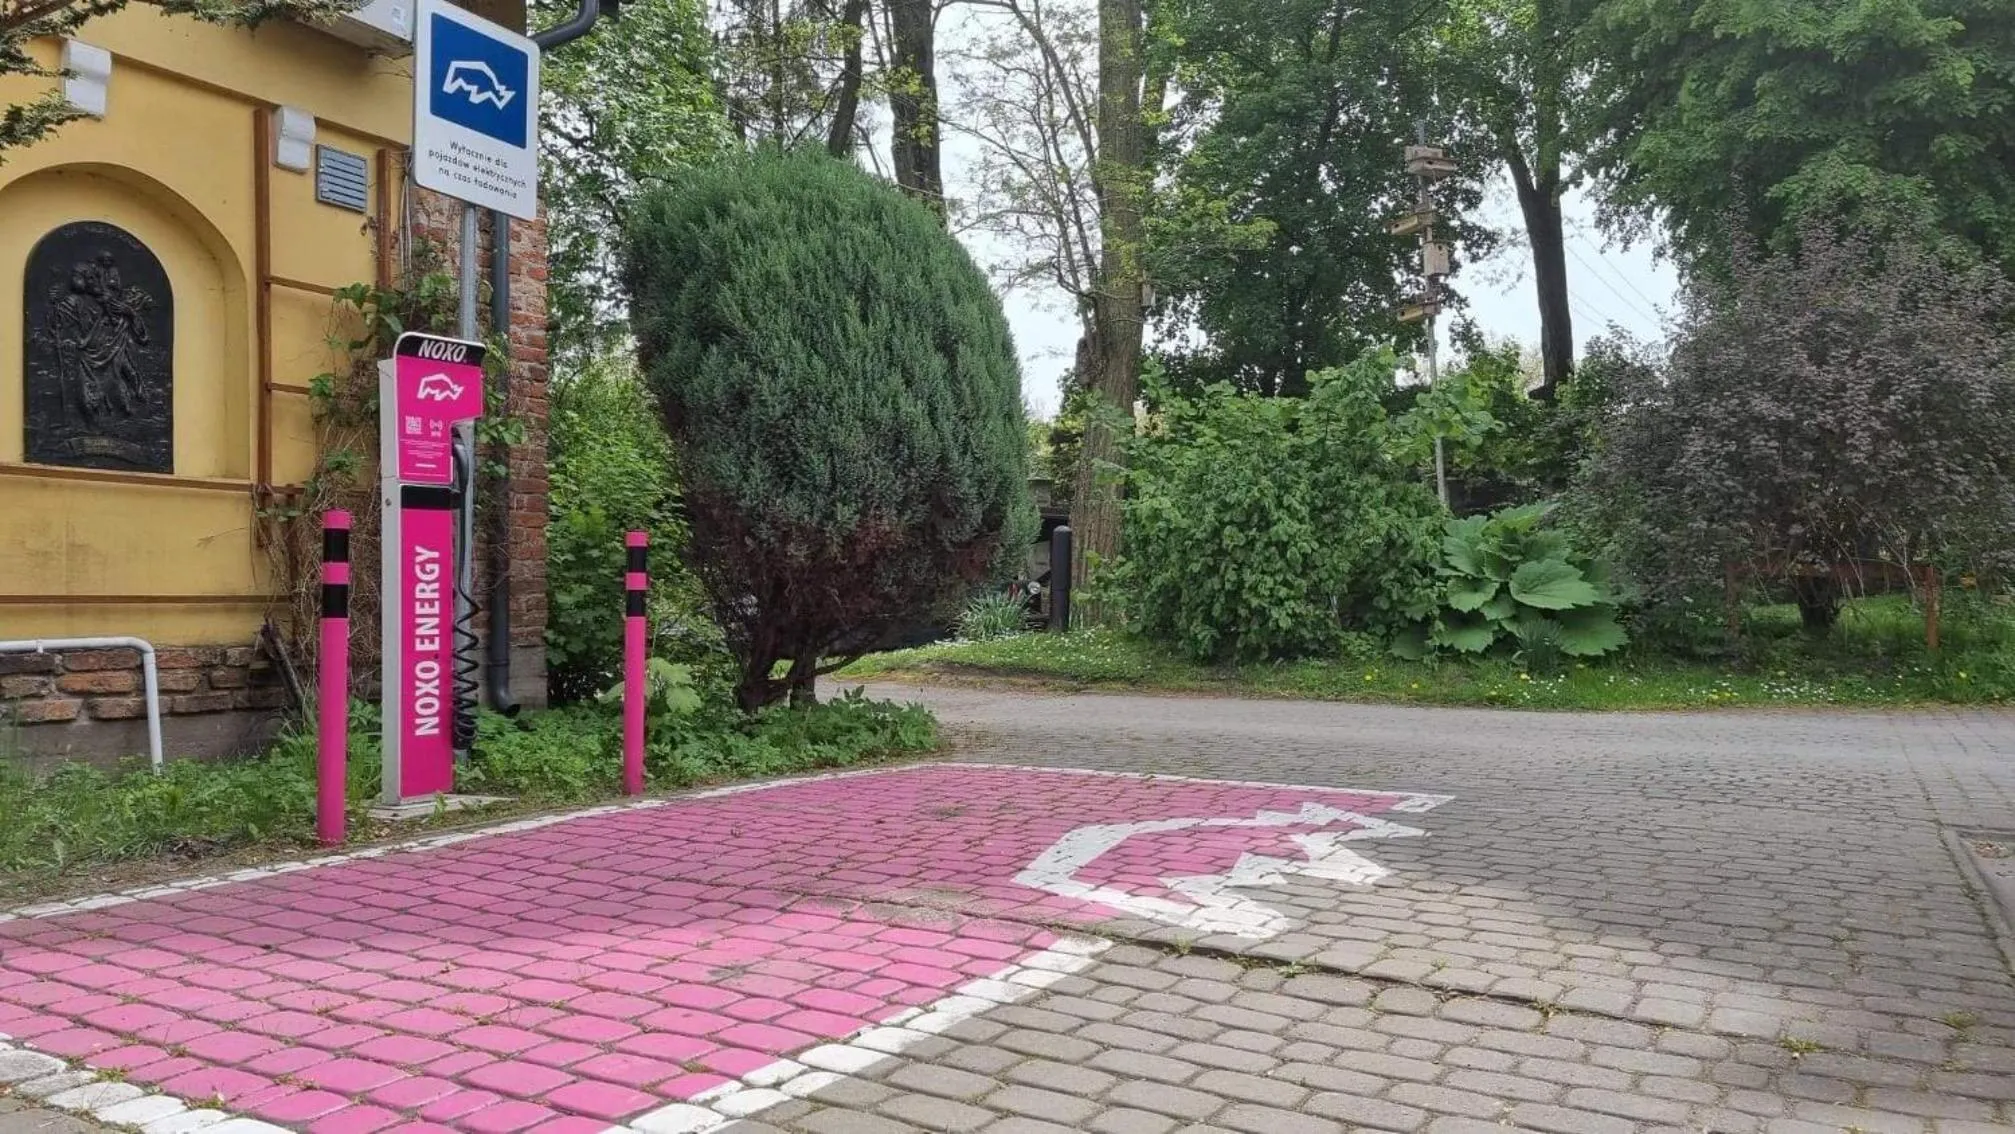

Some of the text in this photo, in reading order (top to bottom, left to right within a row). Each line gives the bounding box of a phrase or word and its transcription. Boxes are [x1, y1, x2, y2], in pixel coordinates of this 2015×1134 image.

[429, 150, 527, 188] pojazdów elektrycznych
[450, 141, 507, 168] Wyłącznie dla
[439, 168, 517, 198] na czas ładowania
[415, 545, 440, 651] ENERGY
